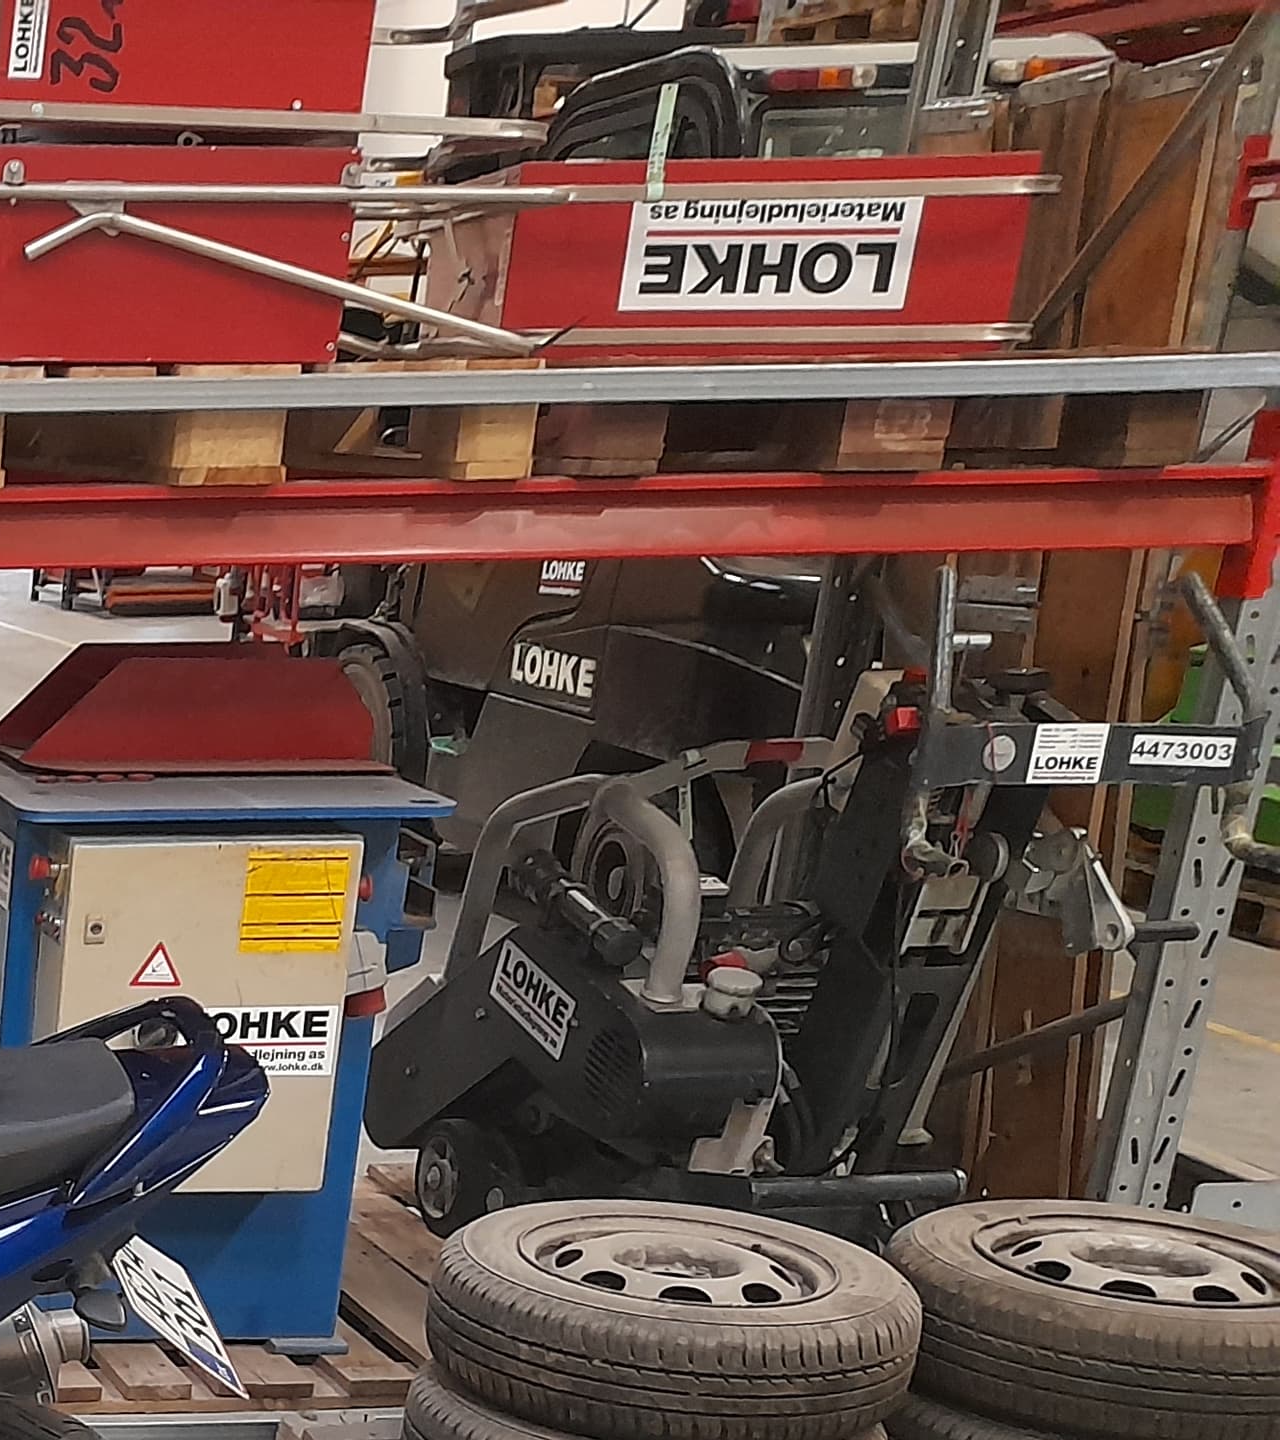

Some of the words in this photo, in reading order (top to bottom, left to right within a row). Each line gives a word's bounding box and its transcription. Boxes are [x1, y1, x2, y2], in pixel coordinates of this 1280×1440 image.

[650, 203, 678, 221] as
[684, 199, 906, 223] Materieludlejning
[638, 242, 898, 295] LOHKE
[541, 560, 586, 582] LOHKE
[511, 643, 596, 698] LOHKE
[1131, 741, 1233, 761] 4473003
[1034, 756, 1098, 770] LOHKE
[501, 948, 569, 1029] LOHKE
[211, 1010, 330, 1039] OHKE
[309, 1050, 326, 1060] as
